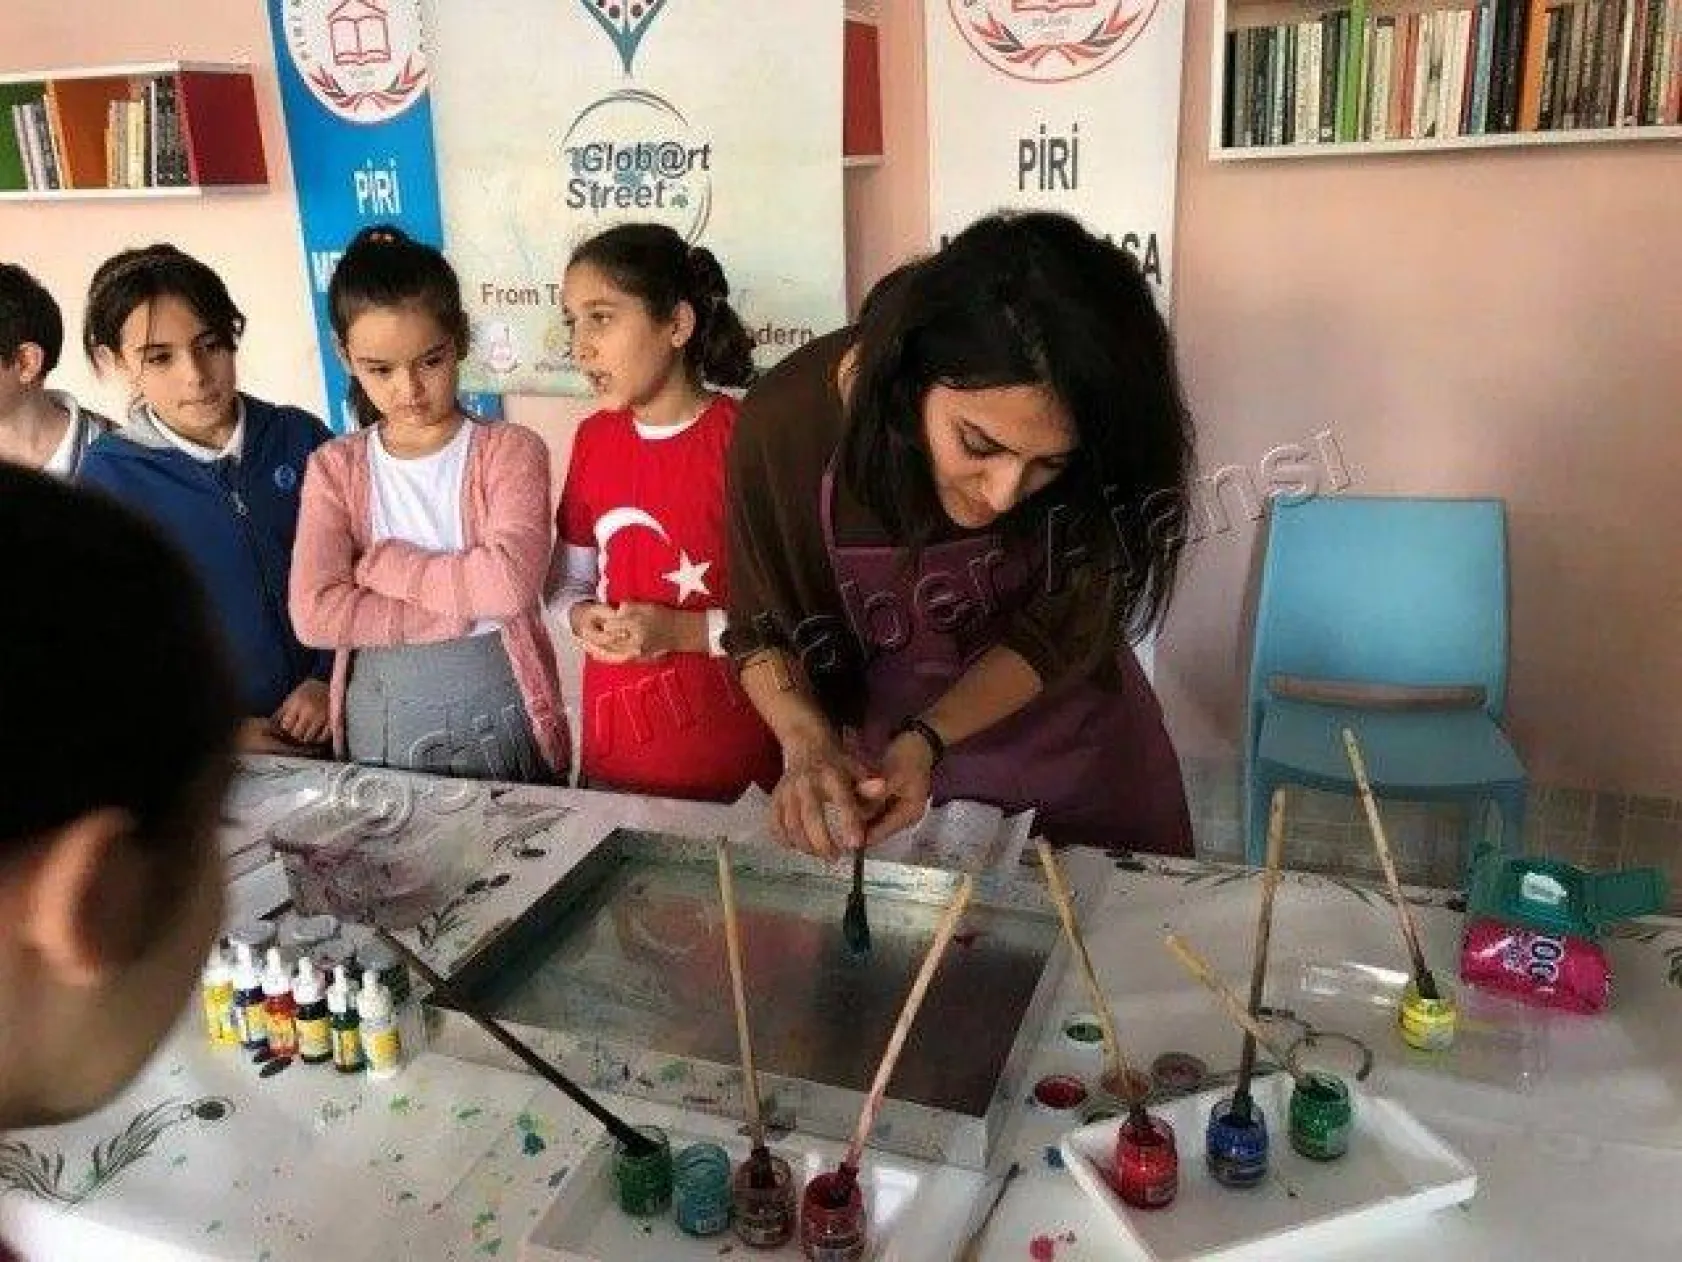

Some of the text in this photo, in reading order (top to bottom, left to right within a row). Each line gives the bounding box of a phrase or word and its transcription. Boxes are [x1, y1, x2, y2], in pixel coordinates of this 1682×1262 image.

[1018, 122, 1078, 192] PİRİ
[353, 157, 402, 216] PİRİ
[566, 178, 664, 209] Street
[481, 283, 539, 306] From
